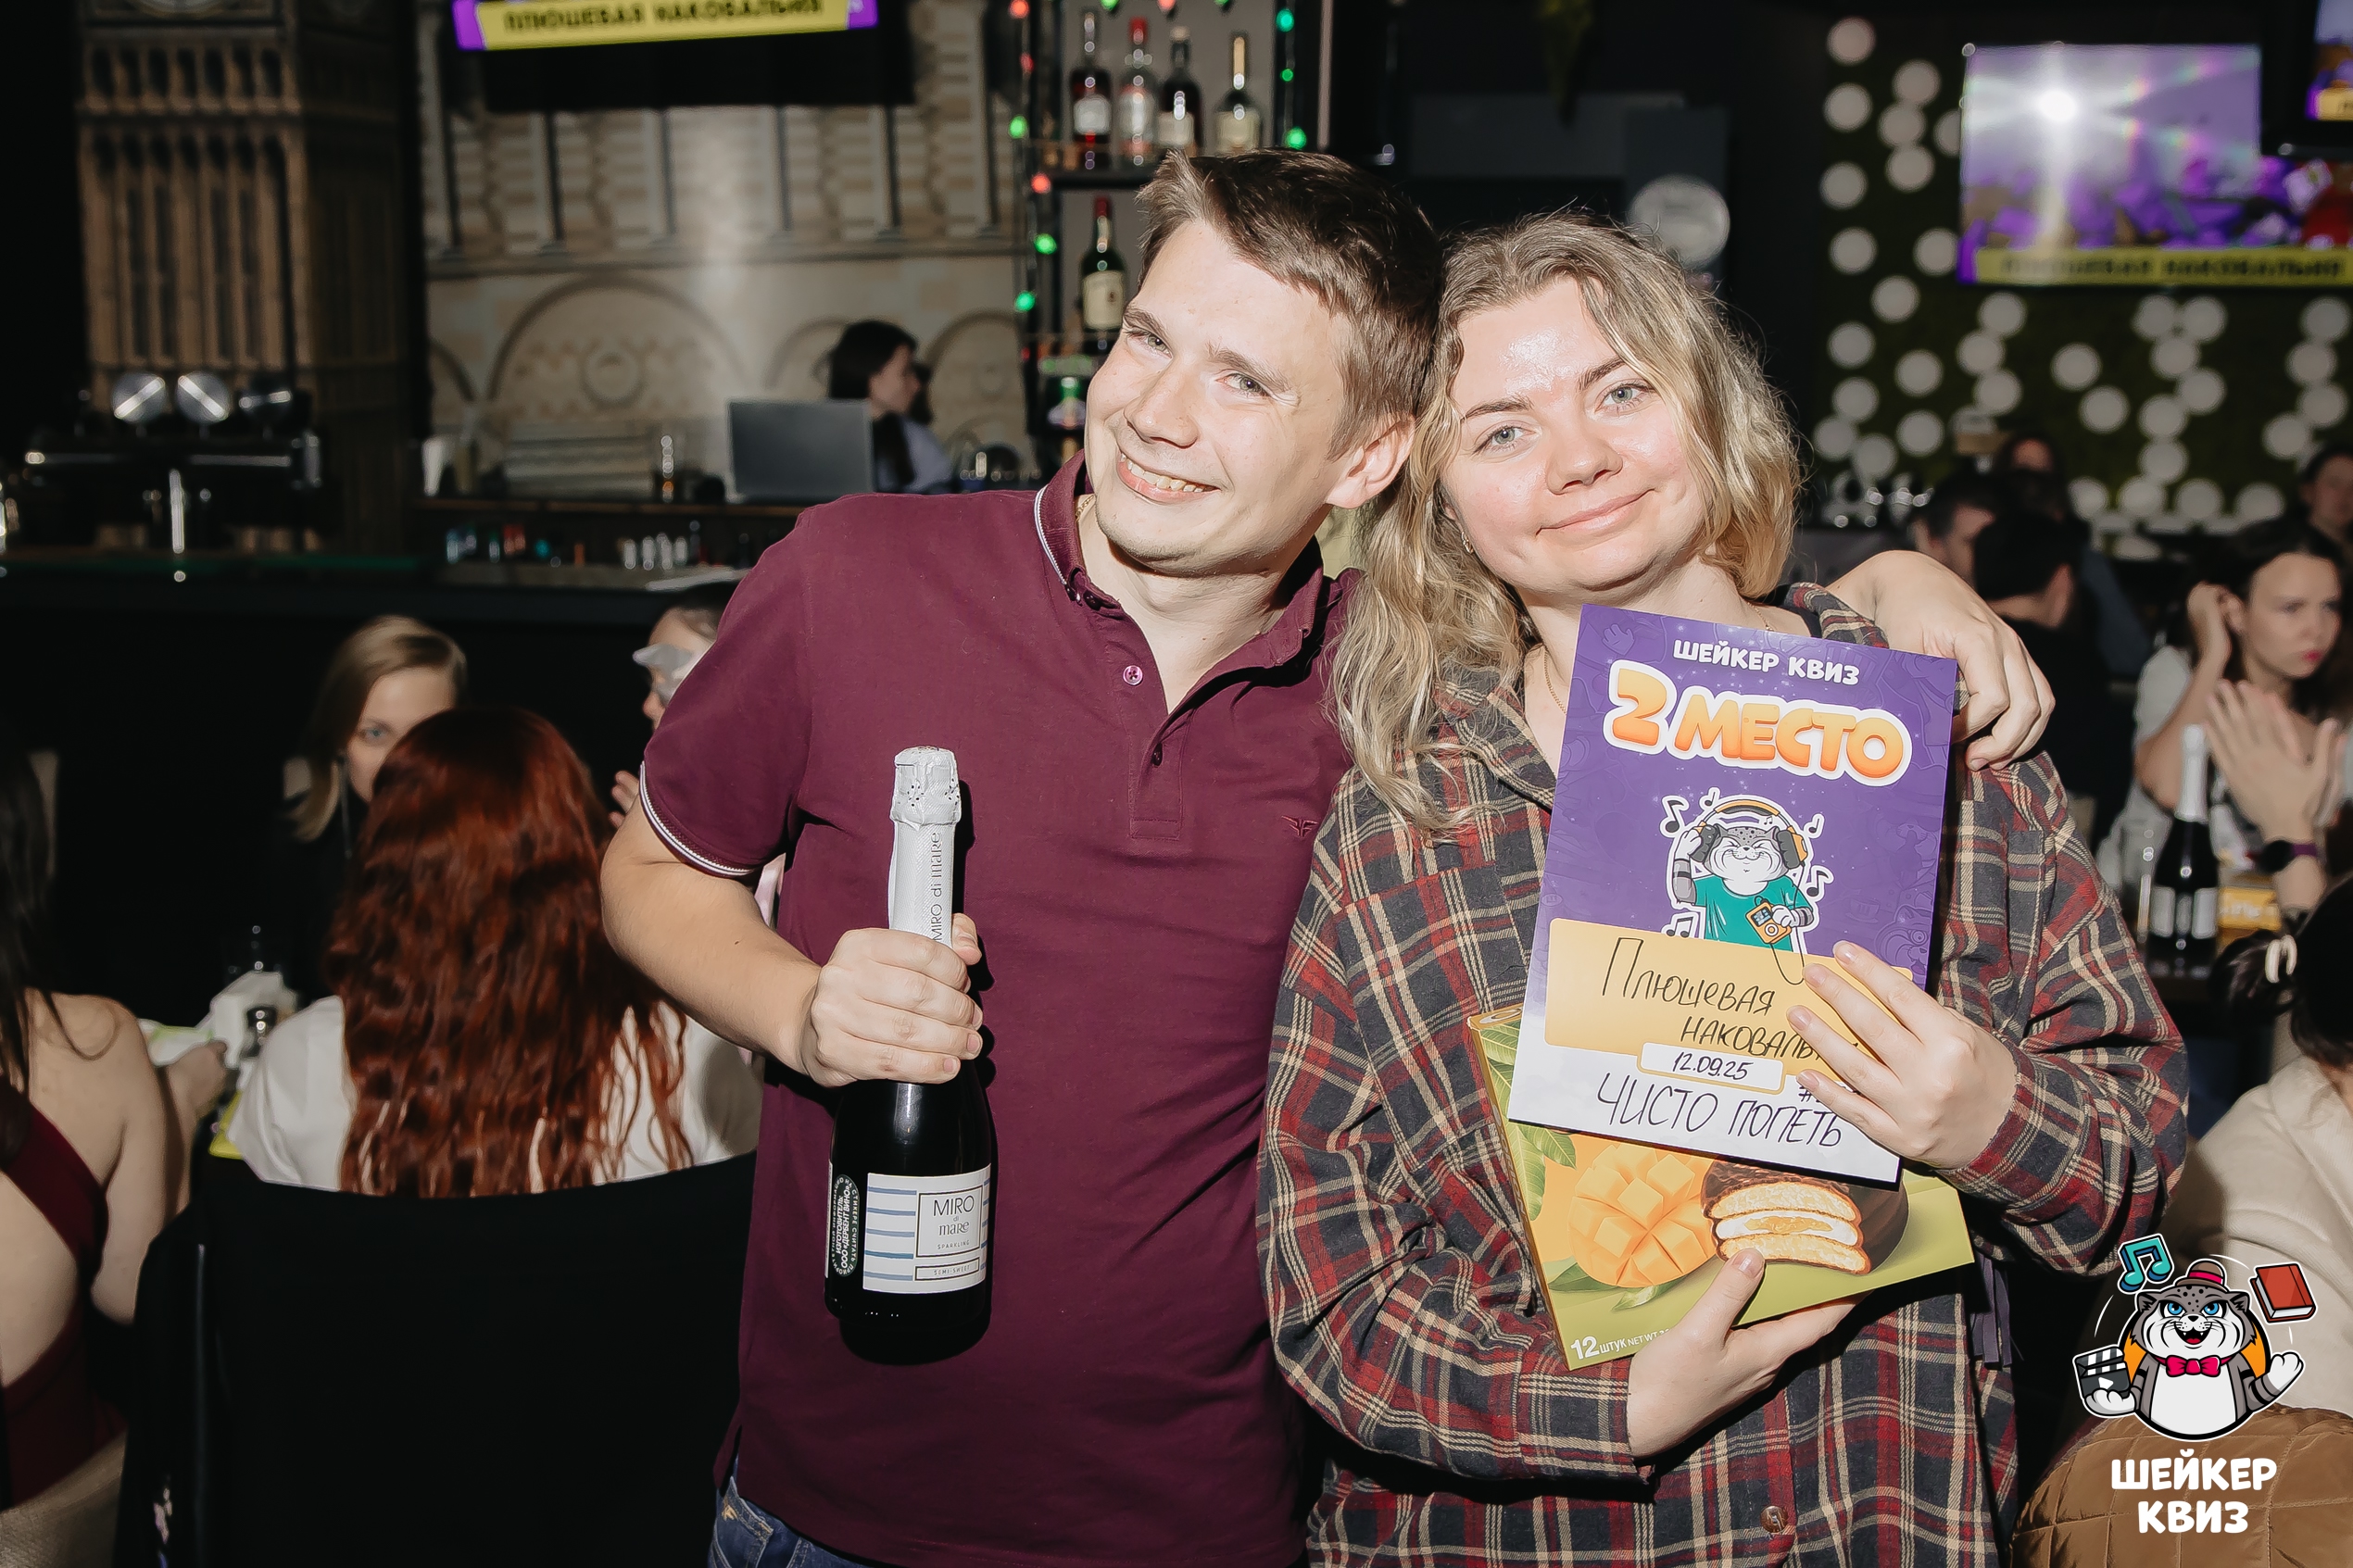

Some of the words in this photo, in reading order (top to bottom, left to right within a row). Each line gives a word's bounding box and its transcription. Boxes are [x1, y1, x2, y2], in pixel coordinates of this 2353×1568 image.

[1672, 639, 1780, 672] ШЕЙКЕР
[1788, 656, 1860, 685] КВИЗ
[1605, 662, 1675, 753] 2
[1670, 688, 1908, 784] МЕСТО
[930, 884, 943, 897] di
[930, 903, 943, 941] MIRO
[1680, 1016, 1821, 1060] НАКОВАЛЬ
[1671, 1051, 1754, 1080] 12.09.25
[1596, 1072, 1718, 1133] ЧИСТО
[1727, 1098, 1843, 1148] ПОПЕТЬ
[933, 1195, 975, 1217] MIRO
[937, 1239, 970, 1250] SPARKLING
[933, 1264, 971, 1276] SEMI-SWEET
[1570, 1336, 1600, 1360] 12
[1599, 1338, 1628, 1353] ШТУК
[1628, 1335, 1644, 1347] NET
